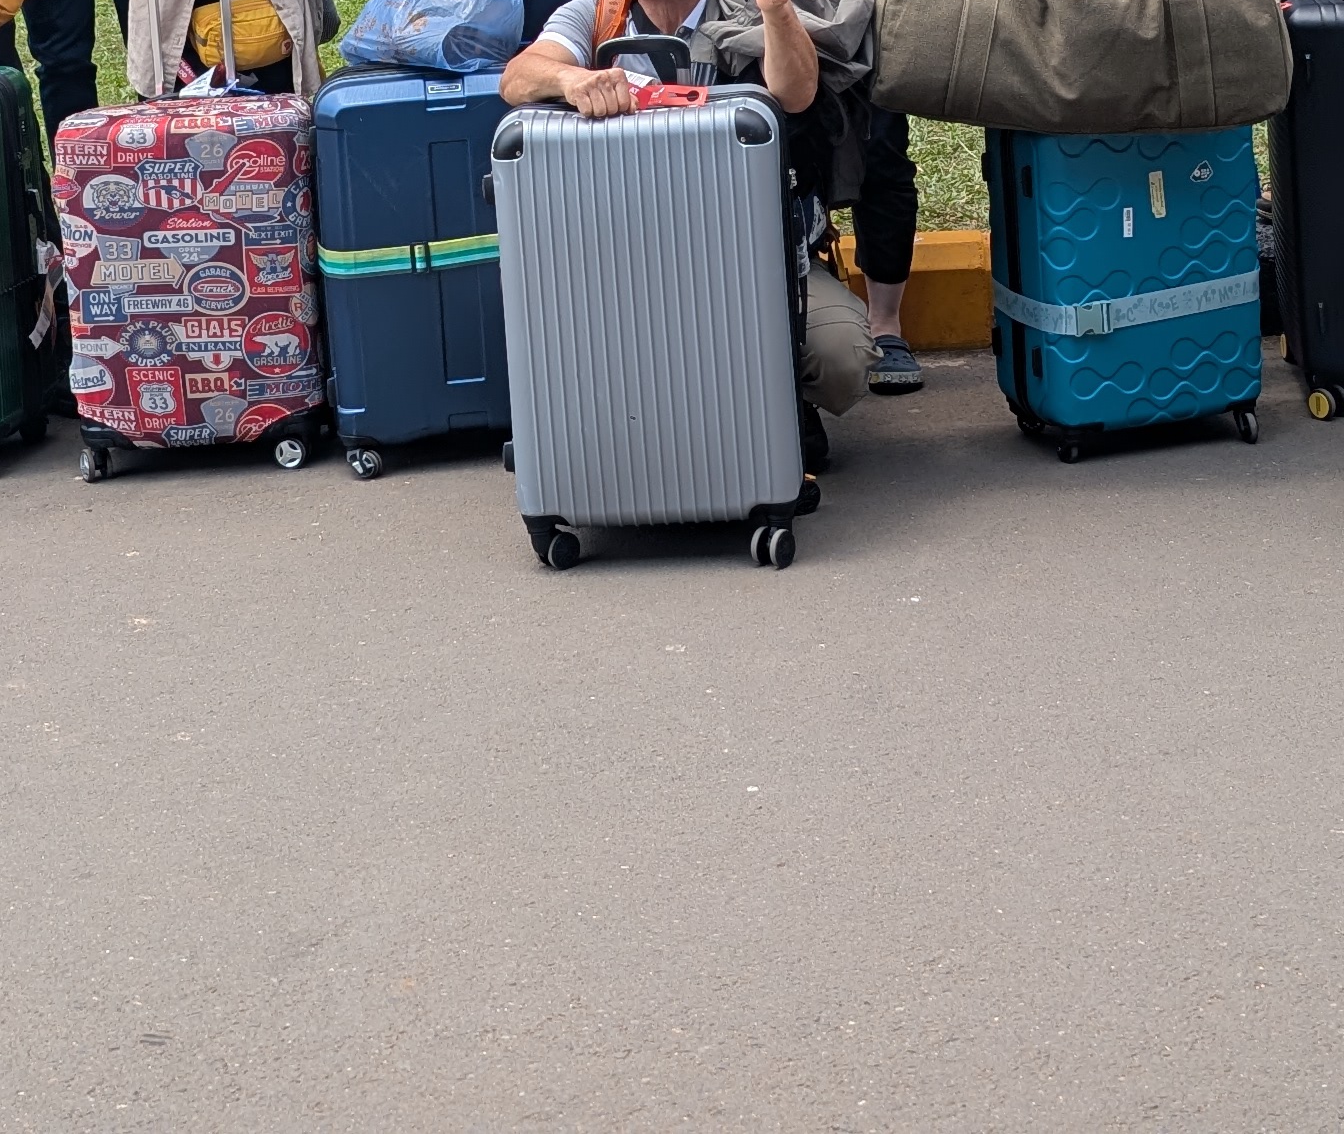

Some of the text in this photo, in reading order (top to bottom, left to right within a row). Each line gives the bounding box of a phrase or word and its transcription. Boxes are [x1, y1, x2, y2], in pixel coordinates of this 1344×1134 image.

[125, 132, 148, 145] 33
[56, 144, 108, 155] STERN
[200, 143, 224, 158] 26
[143, 162, 195, 174] SUPER
[204, 193, 281, 210] MOTEL
[93, 208, 140, 221] Power
[166, 216, 213, 229] Station
[146, 231, 233, 245] GASOLINE
[274, 229, 294, 239] EXIT
[105, 241, 133, 260] 33
[100, 262, 176, 282] MOTEL
[199, 267, 232, 278] GARAGE
[197, 283, 235, 294] Truck
[89, 292, 118, 304] ONE
[127, 297, 190, 311] FREEWAY 46
[200, 299, 235, 310] SERVICE
[89, 304, 118, 316] WAY
[187, 320, 243, 337] GAS
[249, 316, 296, 334] Arctic
[119, 320, 176, 352] SPARK PLUGS
[80, 343, 109, 353] POINT
[128, 353, 172, 368] SUPER
[253, 354, 303, 366] GASOLINE
[132, 370, 176, 381] SCENIC
[148, 396, 169, 410] 33
[214, 407, 235, 423] 26
[170, 428, 211, 441] SUPER
